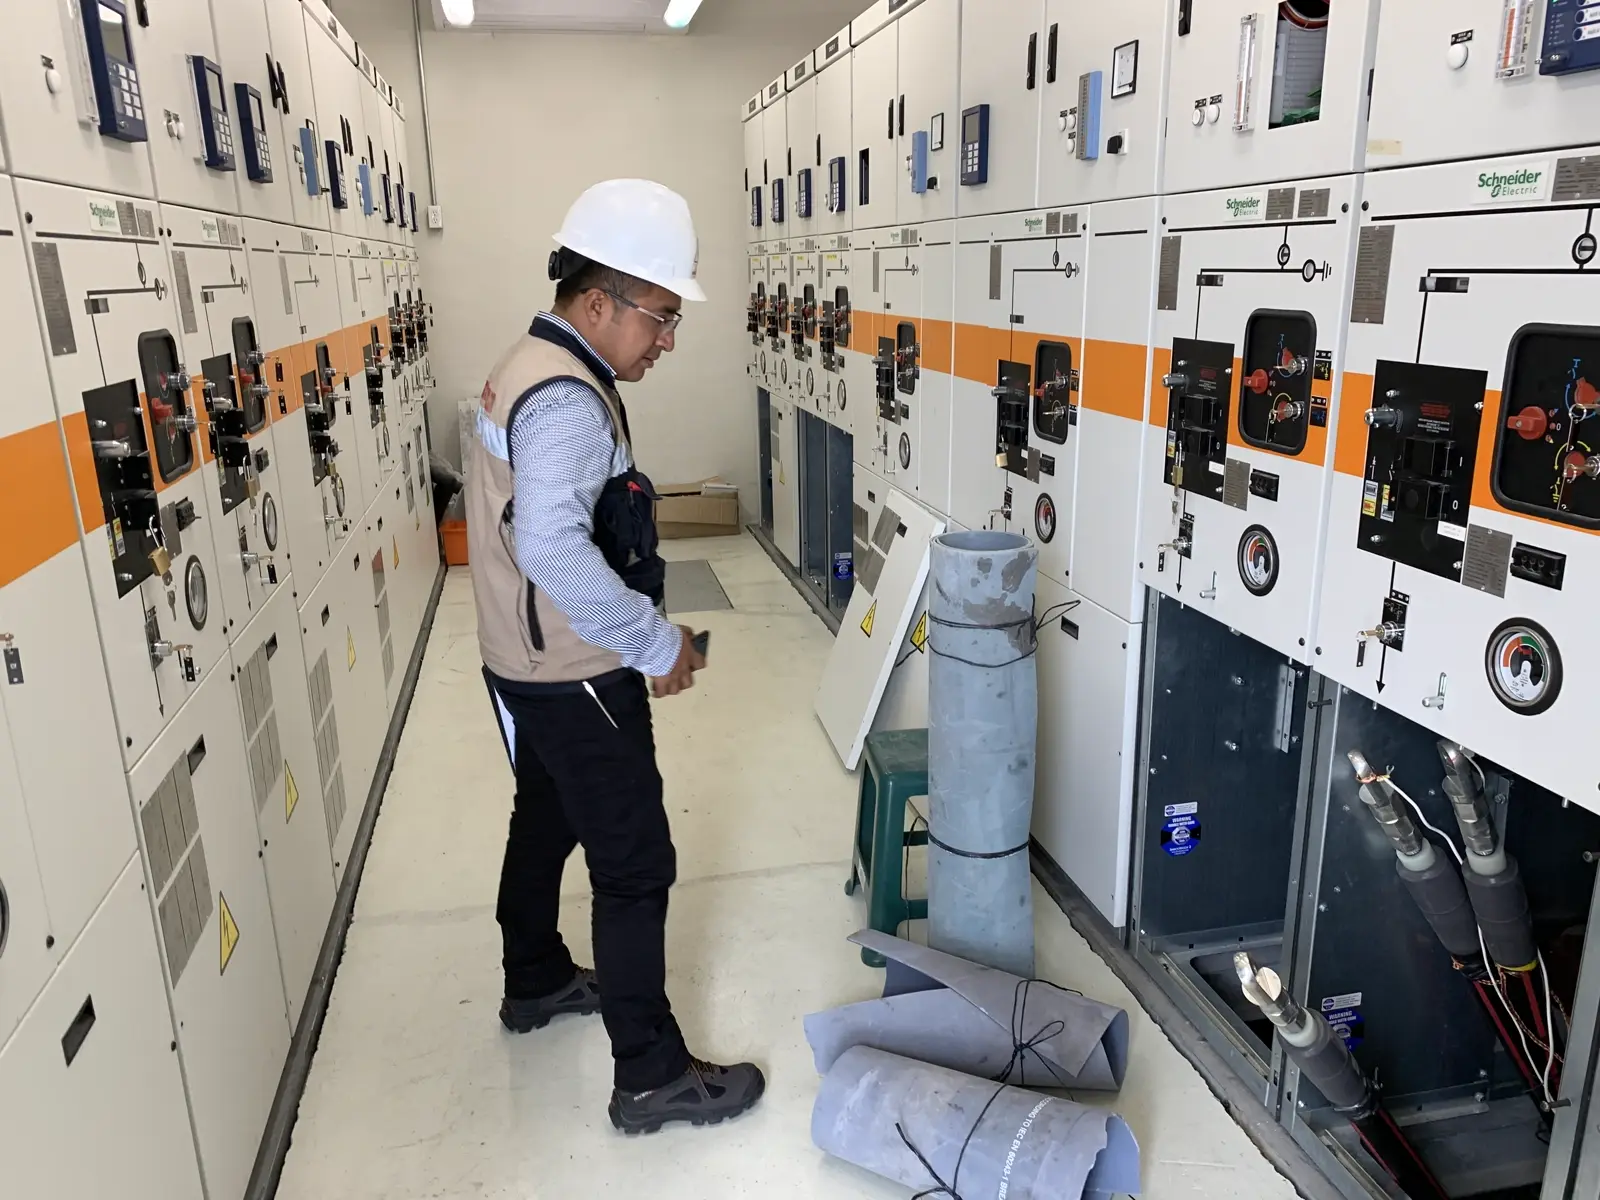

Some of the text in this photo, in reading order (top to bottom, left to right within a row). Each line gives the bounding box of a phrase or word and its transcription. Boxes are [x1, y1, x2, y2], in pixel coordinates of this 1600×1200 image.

[1478, 169, 1542, 187] Schneider
[1502, 186, 1537, 196] Electric
[1226, 197, 1260, 209] Schneider
[1329, 1011, 1352, 1020] WARNING
[1023, 1118, 1032, 1128] TO
[1016, 1126, 1027, 1140] IEC
[1011, 1139, 1021, 1151] EN
[1002, 1151, 1016, 1181] 60243-1
